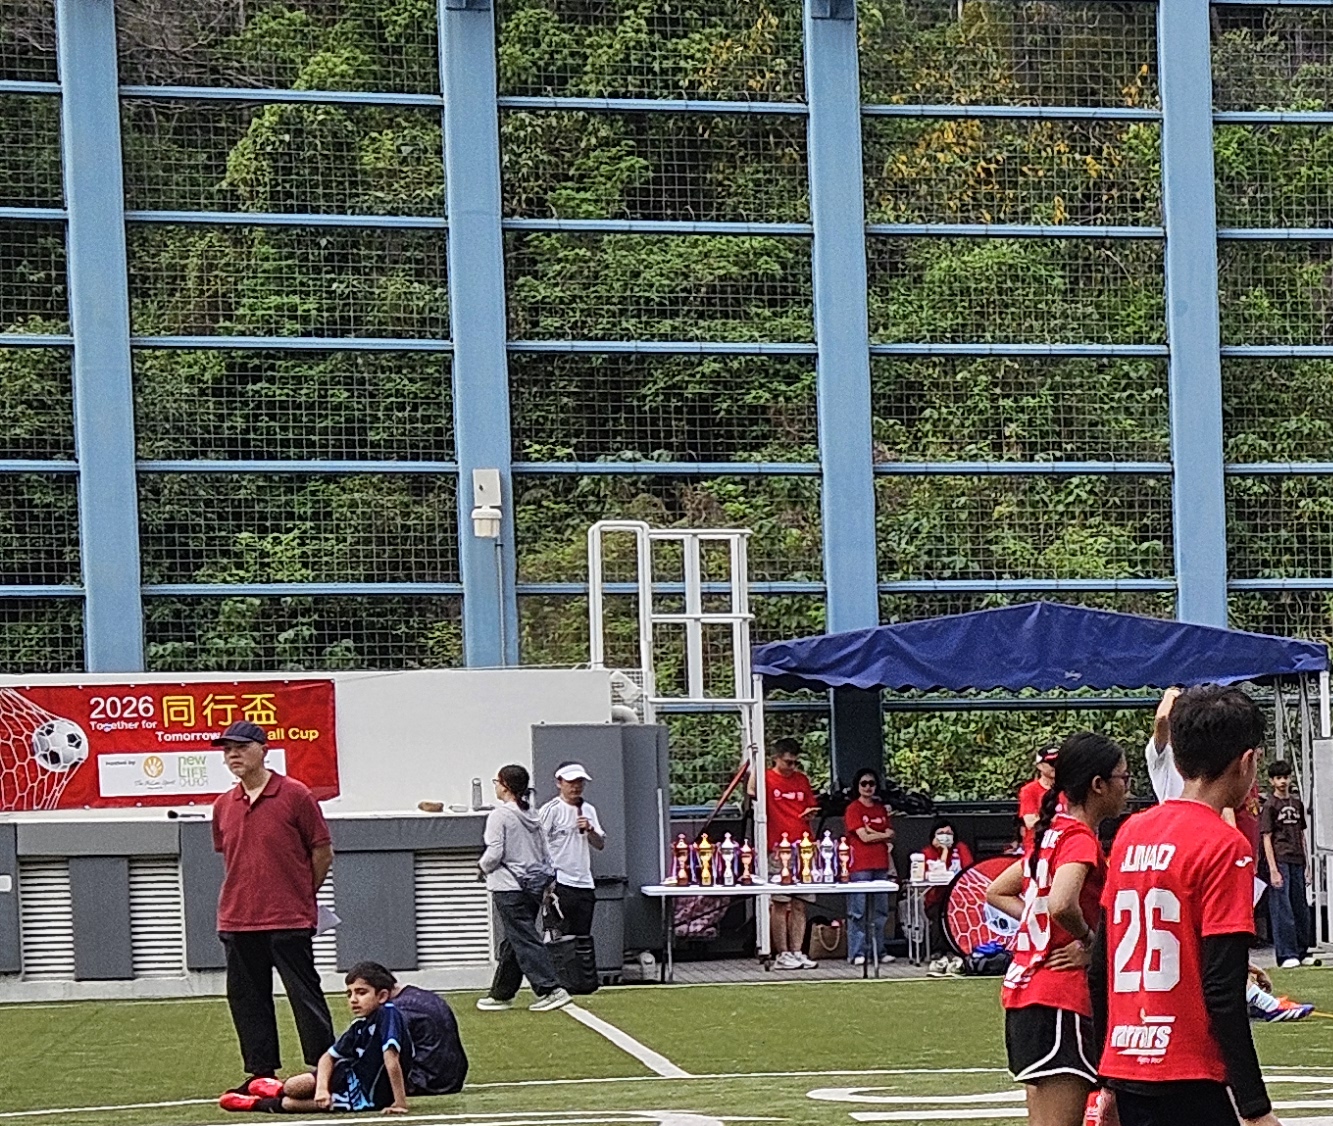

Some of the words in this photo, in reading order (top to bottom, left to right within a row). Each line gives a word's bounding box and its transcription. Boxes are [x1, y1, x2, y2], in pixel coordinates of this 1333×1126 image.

[90, 696, 154, 719] 2026
[162, 693, 278, 728] 同行盃
[90, 720, 139, 732] Together
[141, 719, 157, 729] for
[155, 731, 222, 742] Tomorrow
[288, 727, 320, 742] Cup
[1113, 887, 1181, 993] 26
